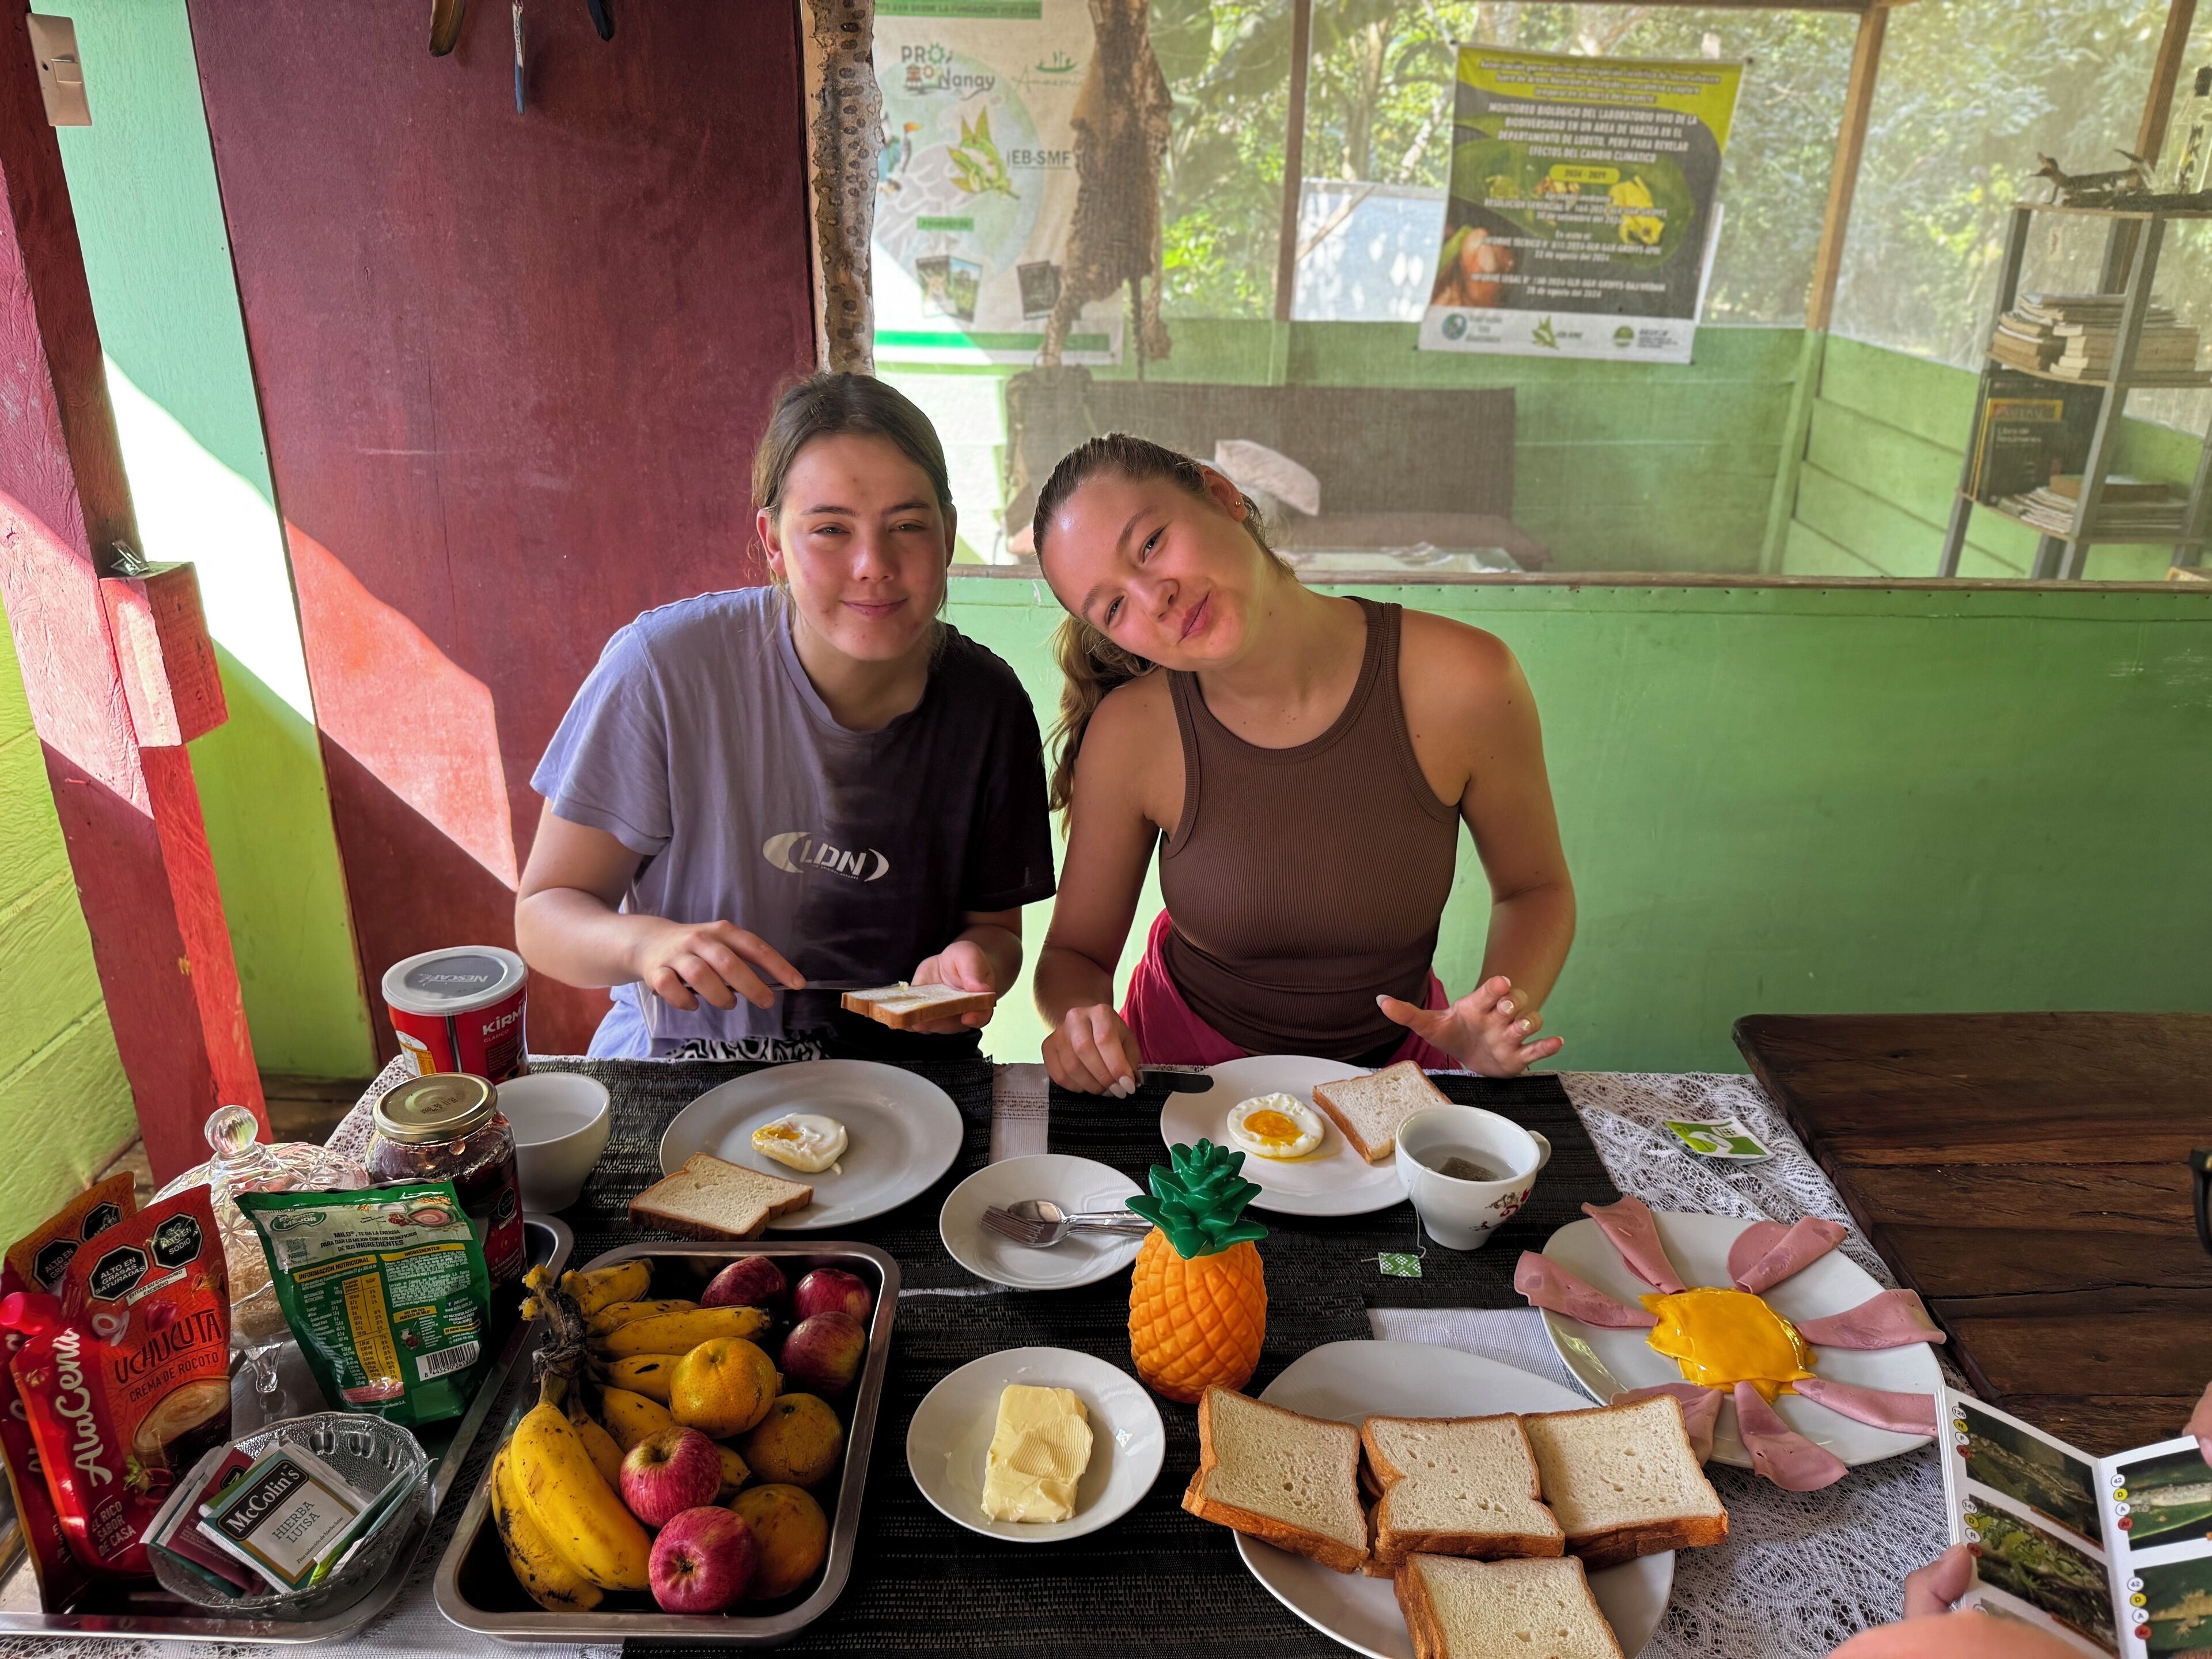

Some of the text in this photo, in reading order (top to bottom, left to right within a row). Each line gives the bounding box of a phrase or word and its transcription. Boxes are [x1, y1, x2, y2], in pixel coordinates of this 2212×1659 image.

[938, 68, 995, 89] Nanay
[169, 1237, 191, 1255] SODIO
[356, 1240, 404, 1249] INGREDIENTES
[45, 1248, 74, 1274] ALTO EN
[101, 1256, 137, 1279] ALTO EN
[298, 1266, 335, 1280] INFORMACIÓN
[335, 1257, 370, 1271] NUTRICIONAL
[95, 1266, 146, 1295] SATURADAS
[102, 1264, 137, 1285] GRASAS
[128, 1270, 183, 1300] EVITAR SU CONSUMO
[143, 1281, 169, 1296] EXCESIVO
[115, 1308, 222, 1384] UCHUCUTA
[130, 1351, 219, 1403] CREMA DE ROCOTO
[432, 1364, 454, 1376] 445290
[226, 1469, 300, 1533] McColin's
[1964, 1502, 1976, 1510] 147
[92, 1501, 122, 1532] EL RICO
[97, 1514, 126, 1541] SABOR
[272, 1501, 315, 1540] HIERBA
[286, 1512, 321, 1544] LUISA
[99, 1524, 137, 1556] DE CASA
